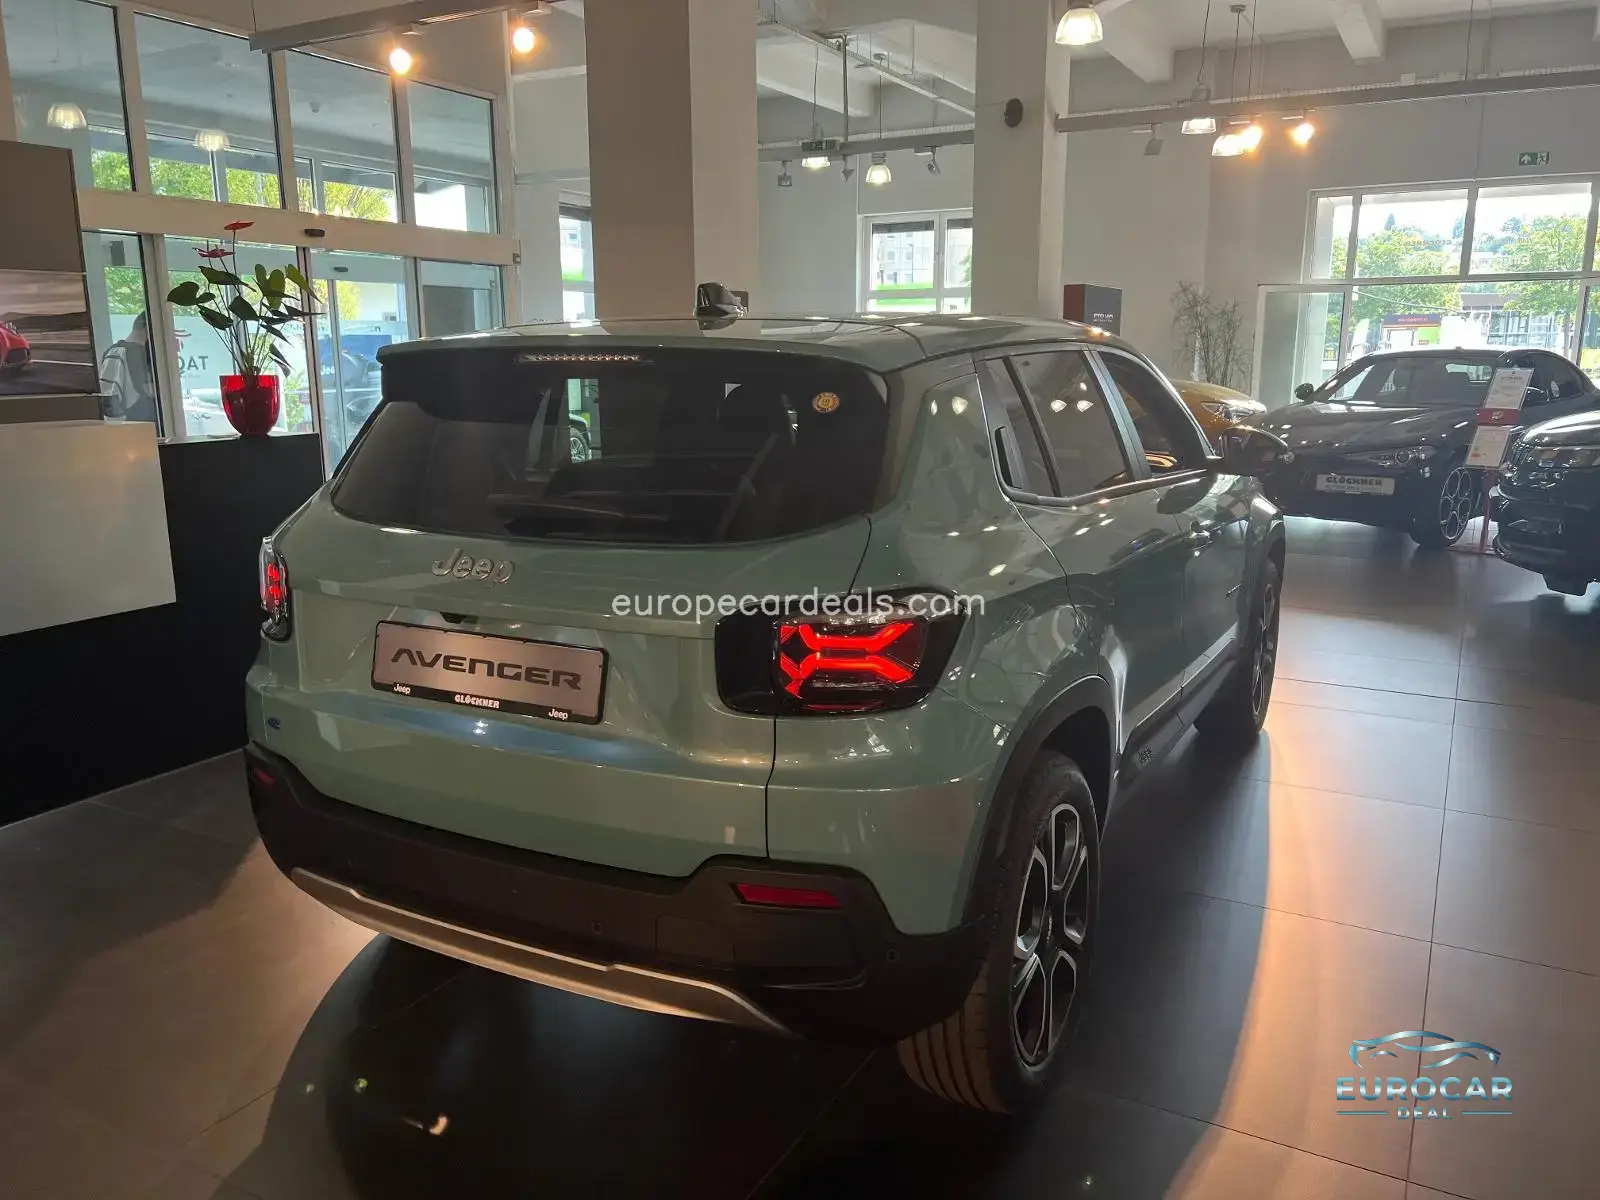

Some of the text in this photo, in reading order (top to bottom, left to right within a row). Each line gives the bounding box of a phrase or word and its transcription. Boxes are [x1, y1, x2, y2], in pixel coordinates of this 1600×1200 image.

[431, 548, 515, 592] Jeep
[391, 648, 583, 691] AVENGER
[393, 683, 411, 695] Jeep
[548, 708, 569, 721] Jeep
